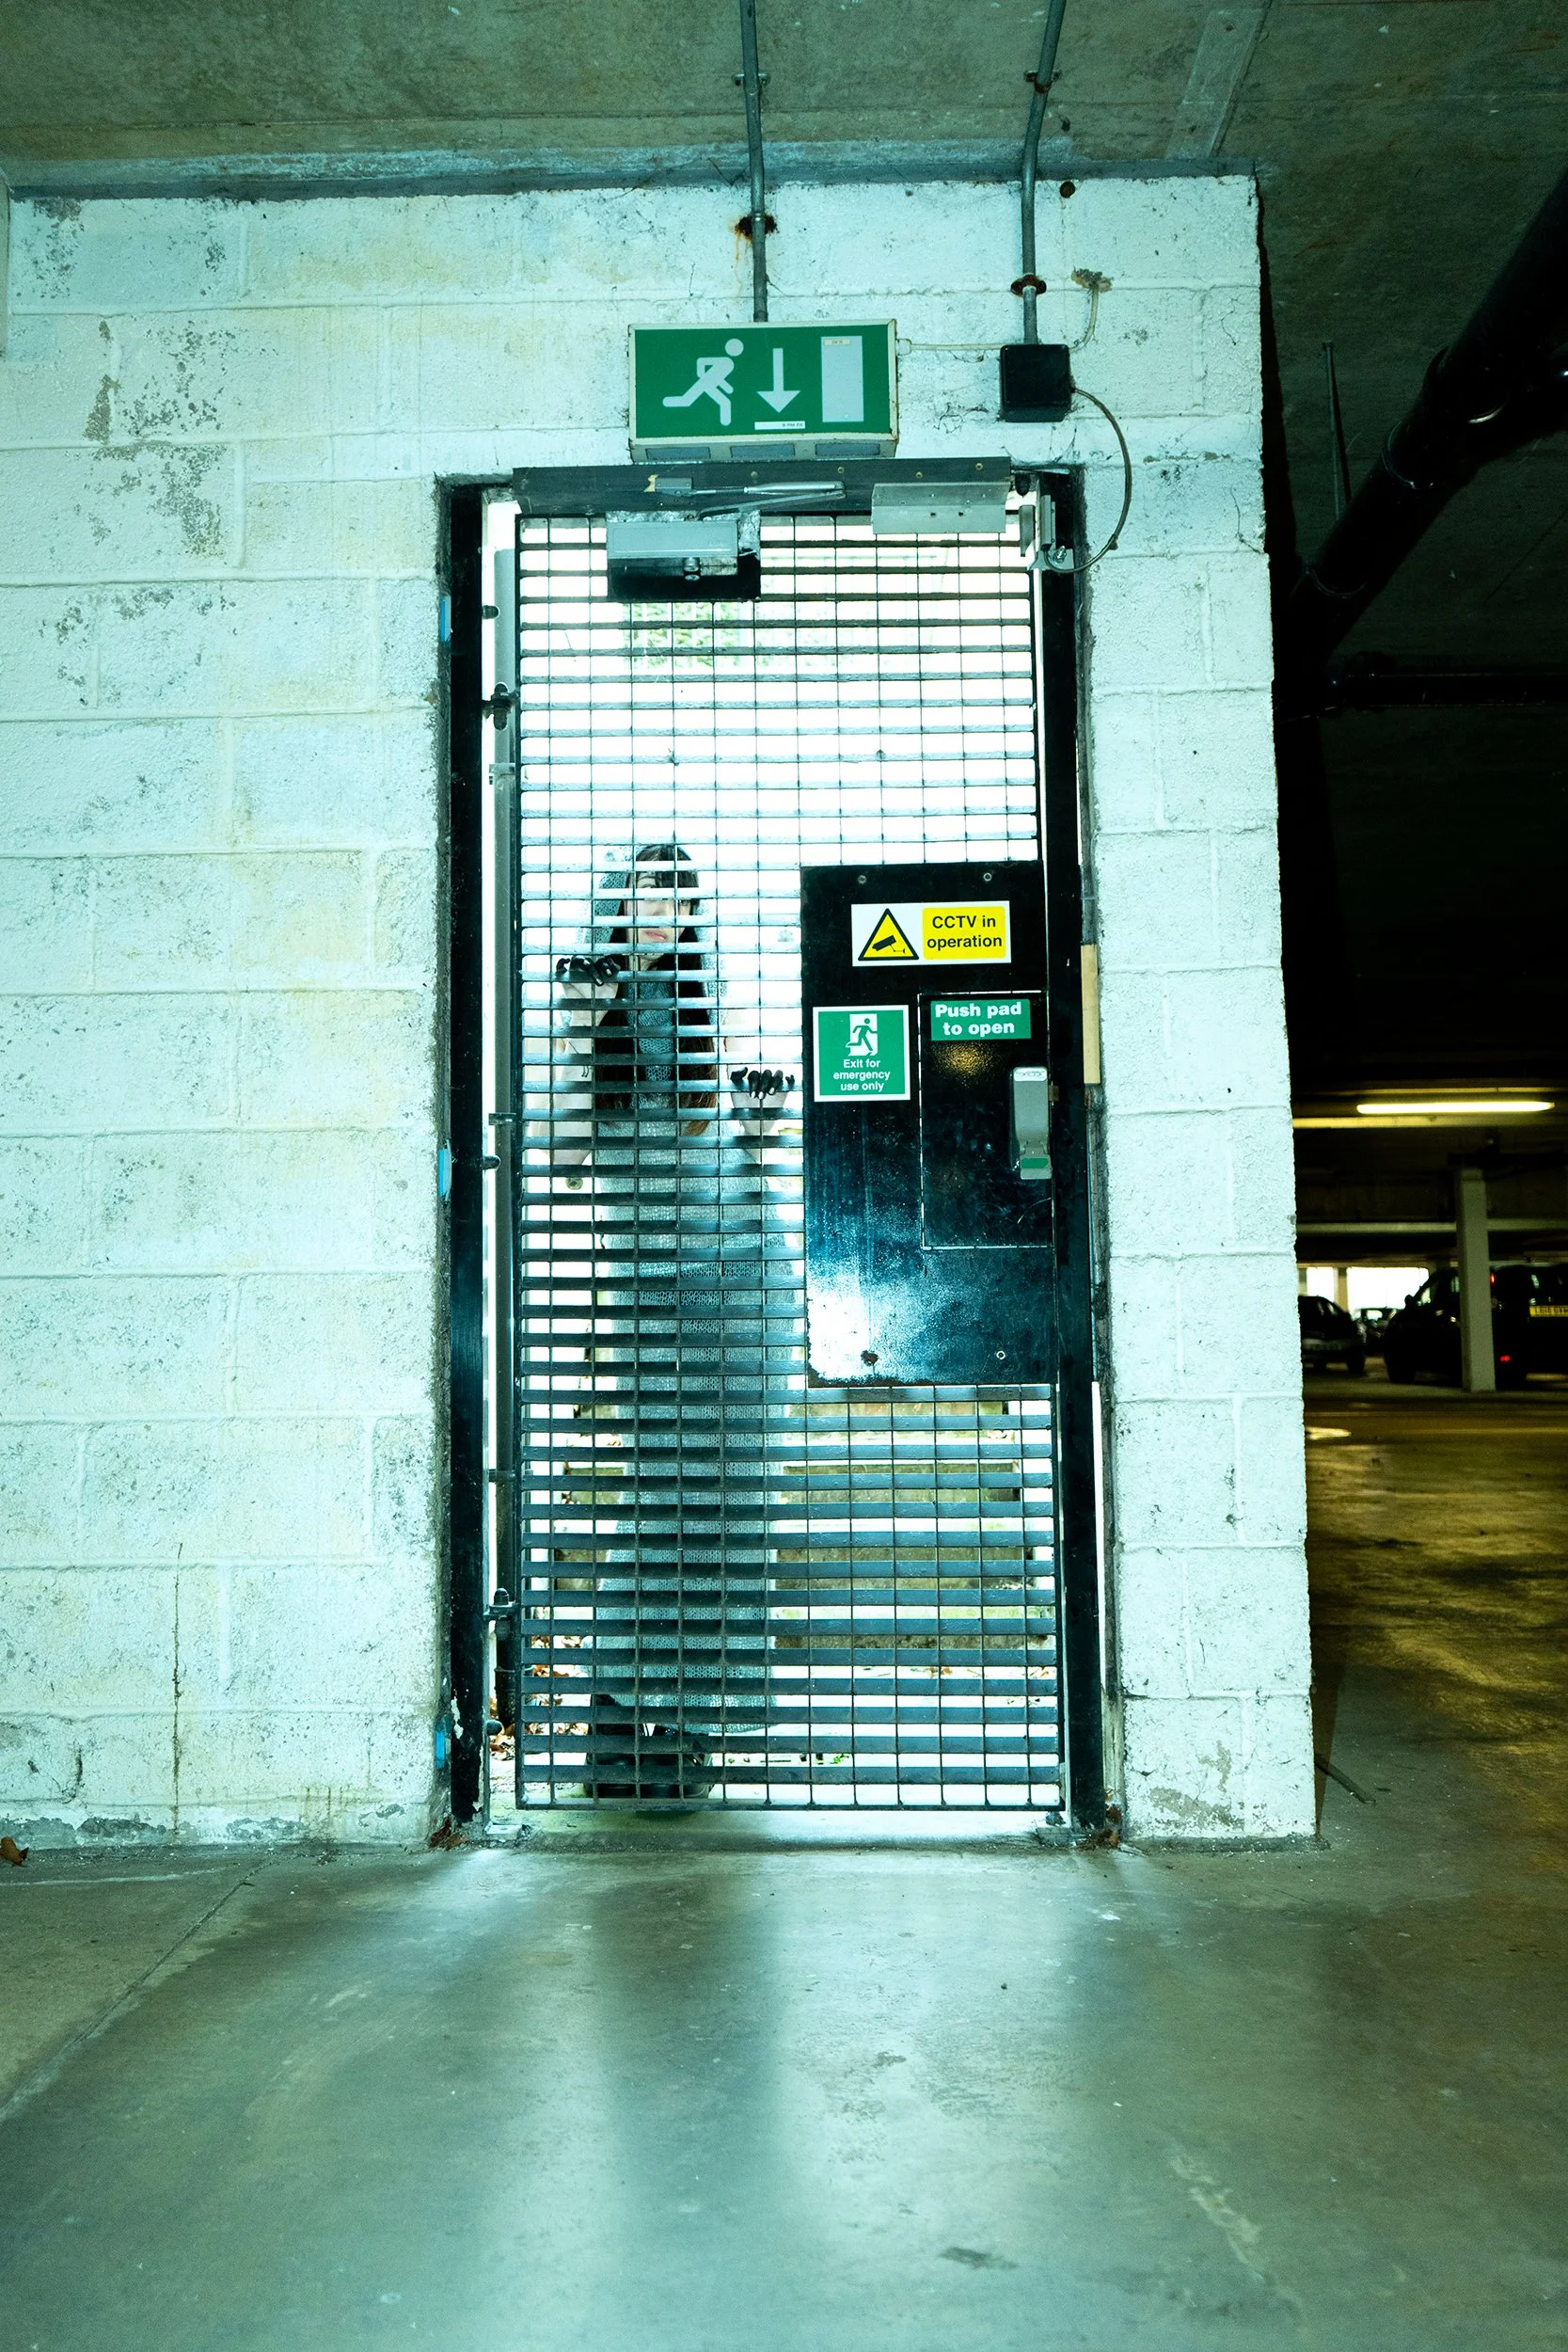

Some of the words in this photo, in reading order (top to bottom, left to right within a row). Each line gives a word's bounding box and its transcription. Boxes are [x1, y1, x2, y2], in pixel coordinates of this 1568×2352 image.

[932, 915, 976, 929] CCTV
[982, 914, 996, 928] in
[927, 934, 1003, 952] operation
[935, 1003, 981, 1018] Push
[987, 1001, 1022, 1019] pad
[942, 1022, 963, 1036] to
[968, 1022, 1015, 1038] open
[843, 1058, 863, 1069] Exit
[865, 1057, 881, 1068] for
[832, 1071, 891, 1082] emergency
[840, 1083, 860, 1091] use
[861, 1080, 885, 1093] only
